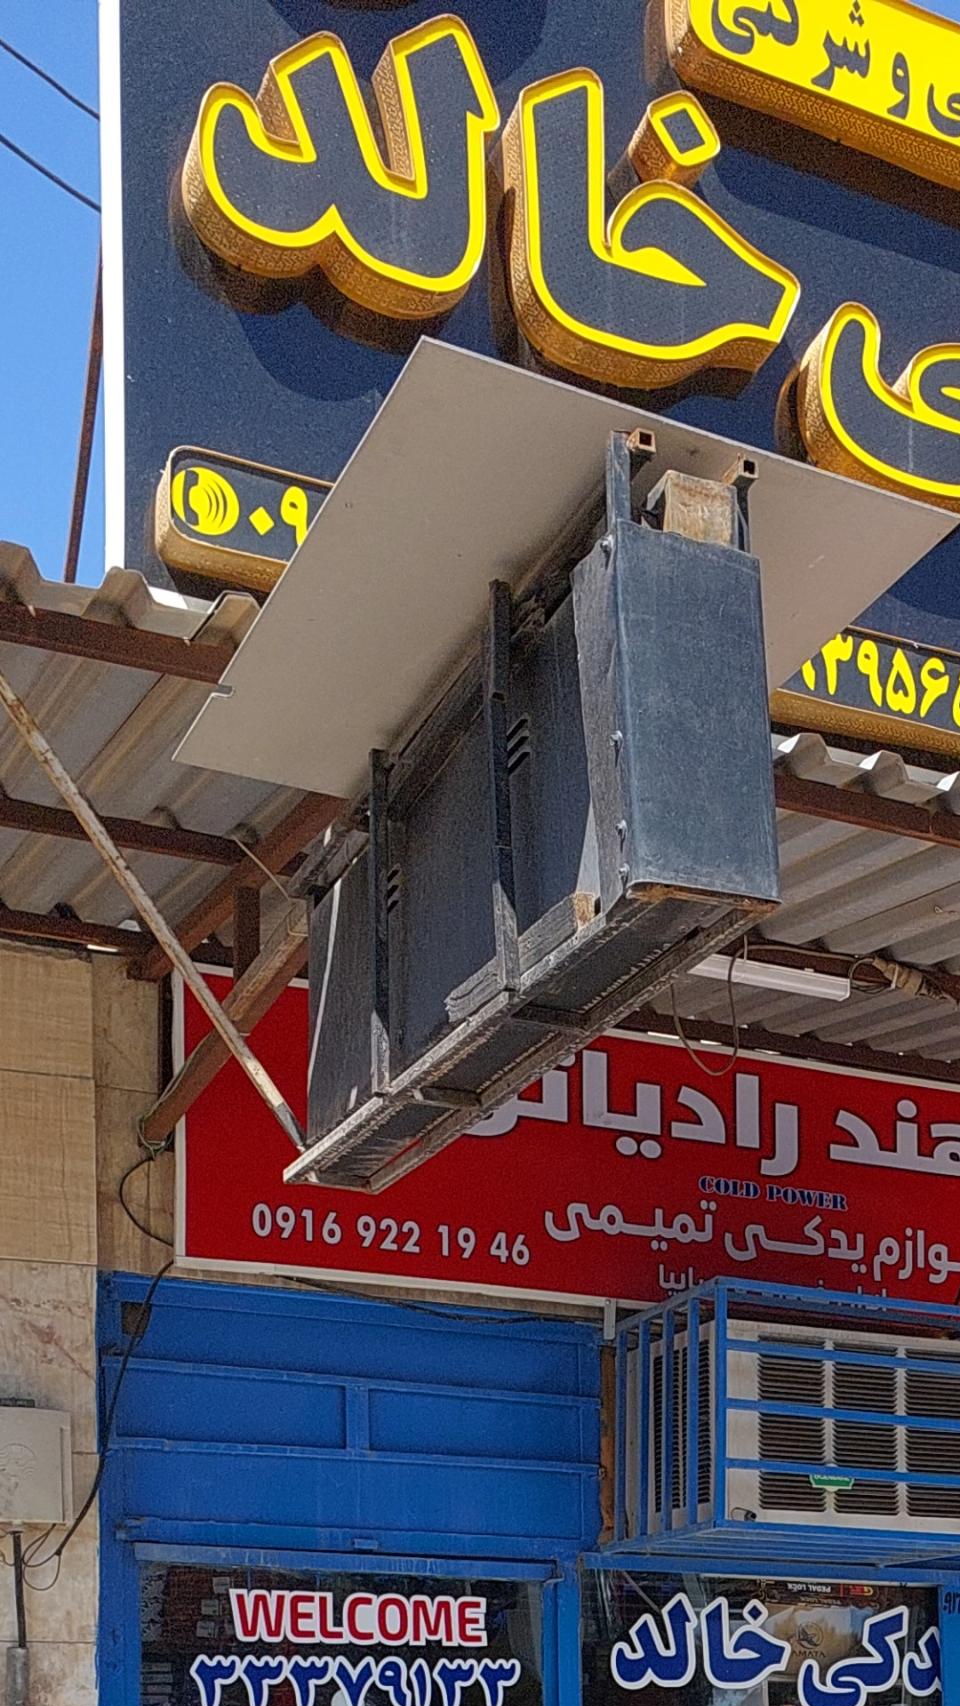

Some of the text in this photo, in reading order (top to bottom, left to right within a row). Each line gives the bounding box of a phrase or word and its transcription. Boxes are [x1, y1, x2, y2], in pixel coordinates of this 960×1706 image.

[886, 52, 911, 120] و
[192, 17, 801, 370] خالد
[698, 1176, 848, 1211] COLD POWER
[252, 1203, 531, 1266] 0916 922 19 46
[545, 1198, 717, 1251] تمیمی
[724, 1216, 867, 1273] یدکی
[231, 1591, 486, 1645] WELCOME
[612, 1593, 789, 1688] خالد
